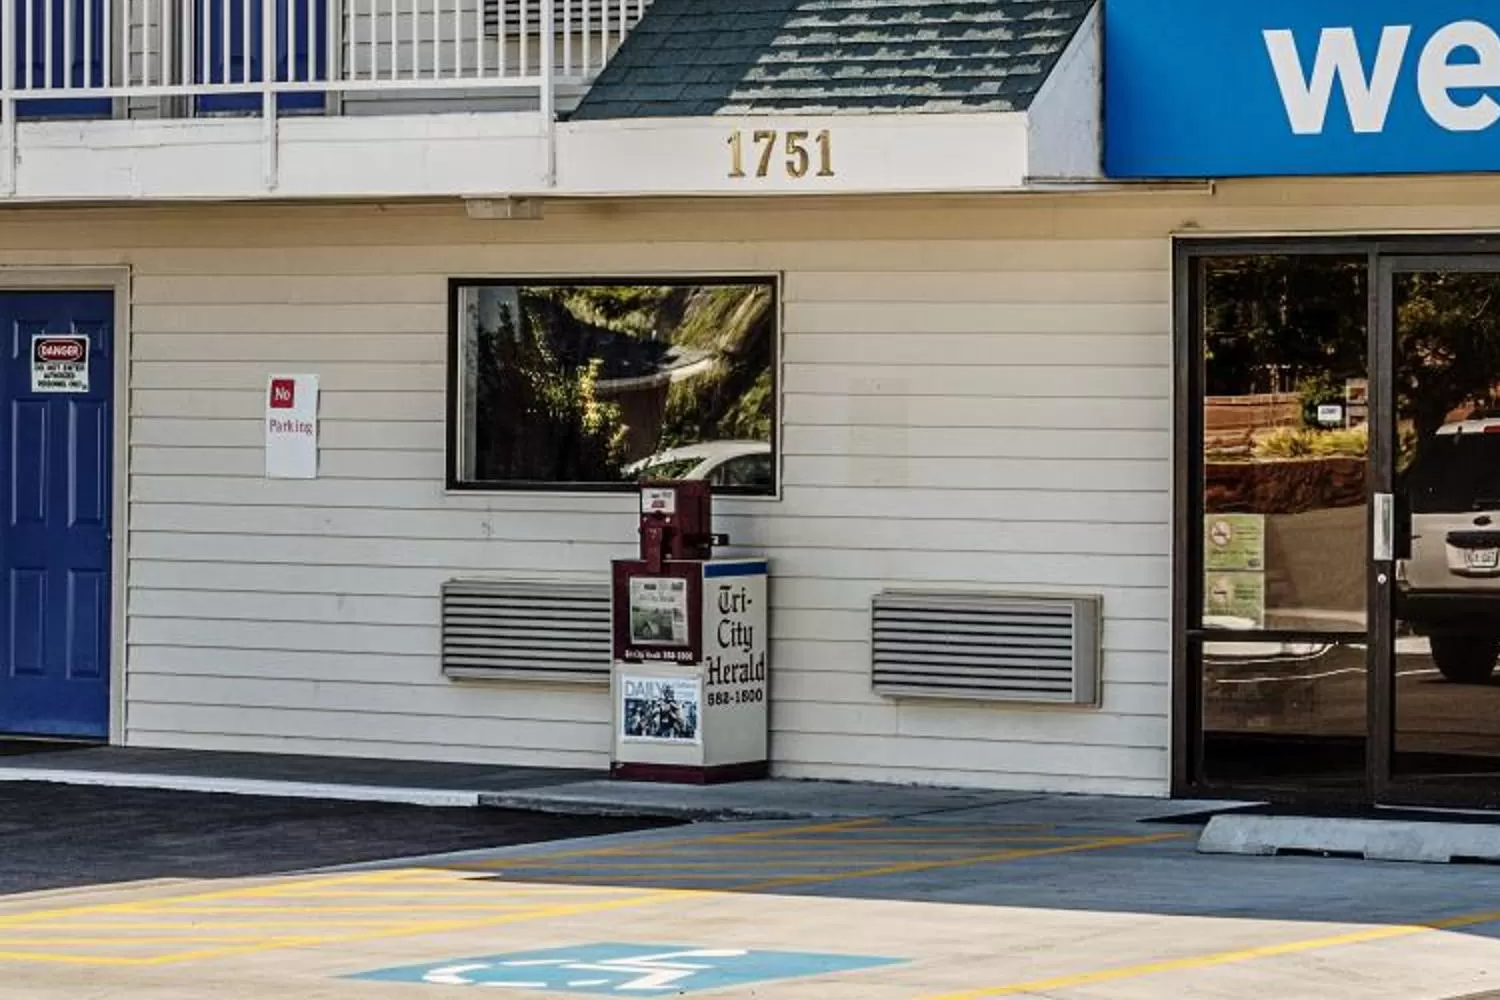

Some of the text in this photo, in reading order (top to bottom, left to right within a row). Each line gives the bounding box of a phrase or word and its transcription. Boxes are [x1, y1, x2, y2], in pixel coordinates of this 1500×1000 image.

[727, 129, 835, 178] 1751
[41, 344, 79, 357] DANGER
[275, 386, 291, 401] No
[269, 419, 314, 436] Parking
[718, 585, 753, 615] Tri-
[717, 618, 753, 653] City
[706, 651, 765, 686] Herald
